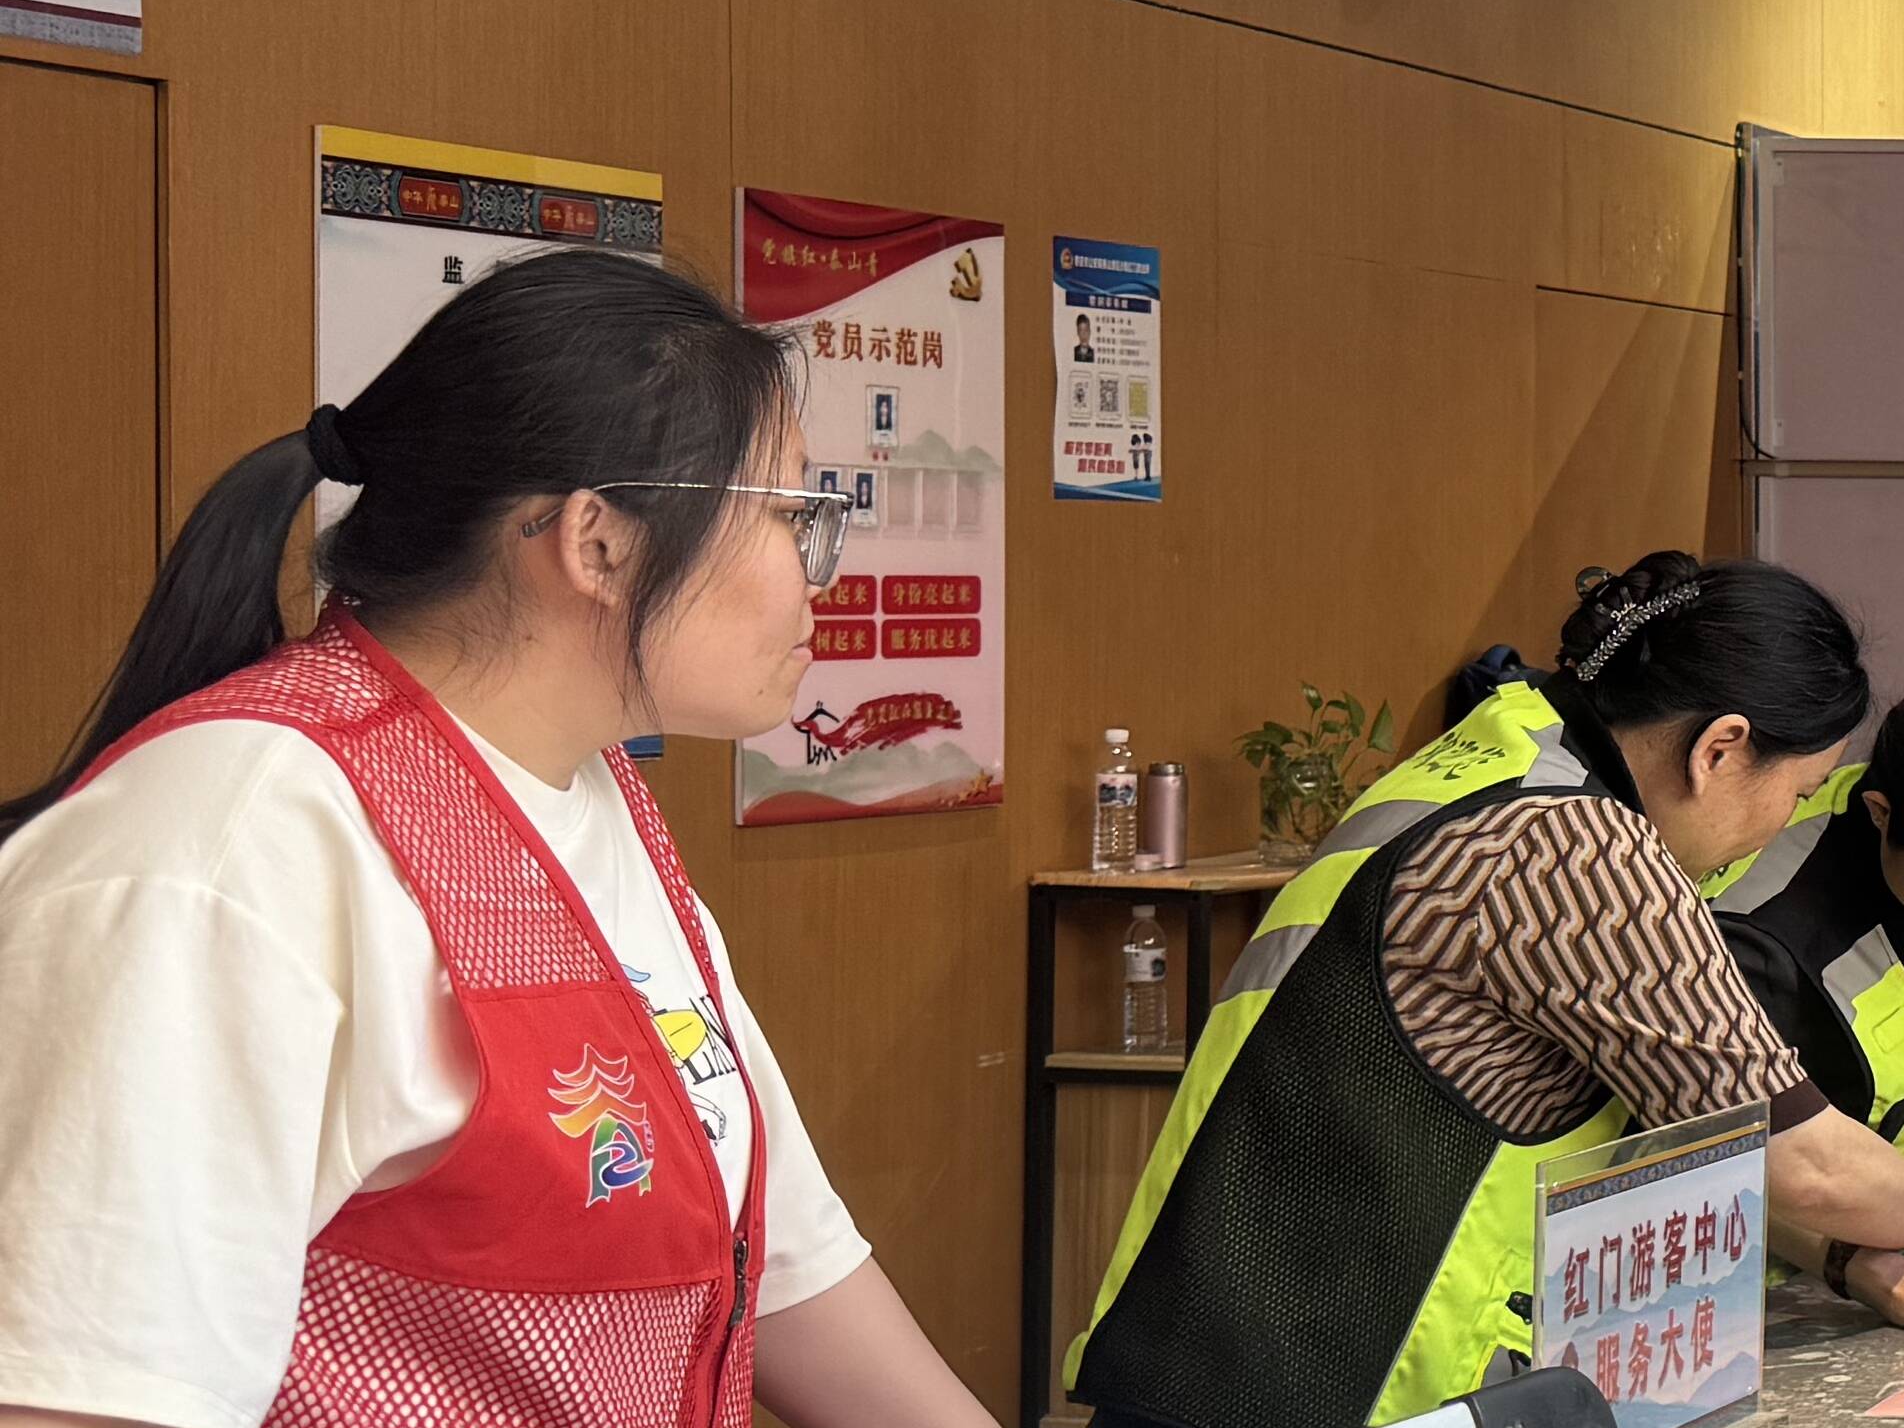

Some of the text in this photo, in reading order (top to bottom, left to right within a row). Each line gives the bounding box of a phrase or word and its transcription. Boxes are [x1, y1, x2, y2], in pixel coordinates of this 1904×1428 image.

[812, 320, 943, 369] 党员示范岗
[1562, 1194, 1747, 1324] 红门游客中心
[1595, 1297, 1716, 1405] 服务大使
